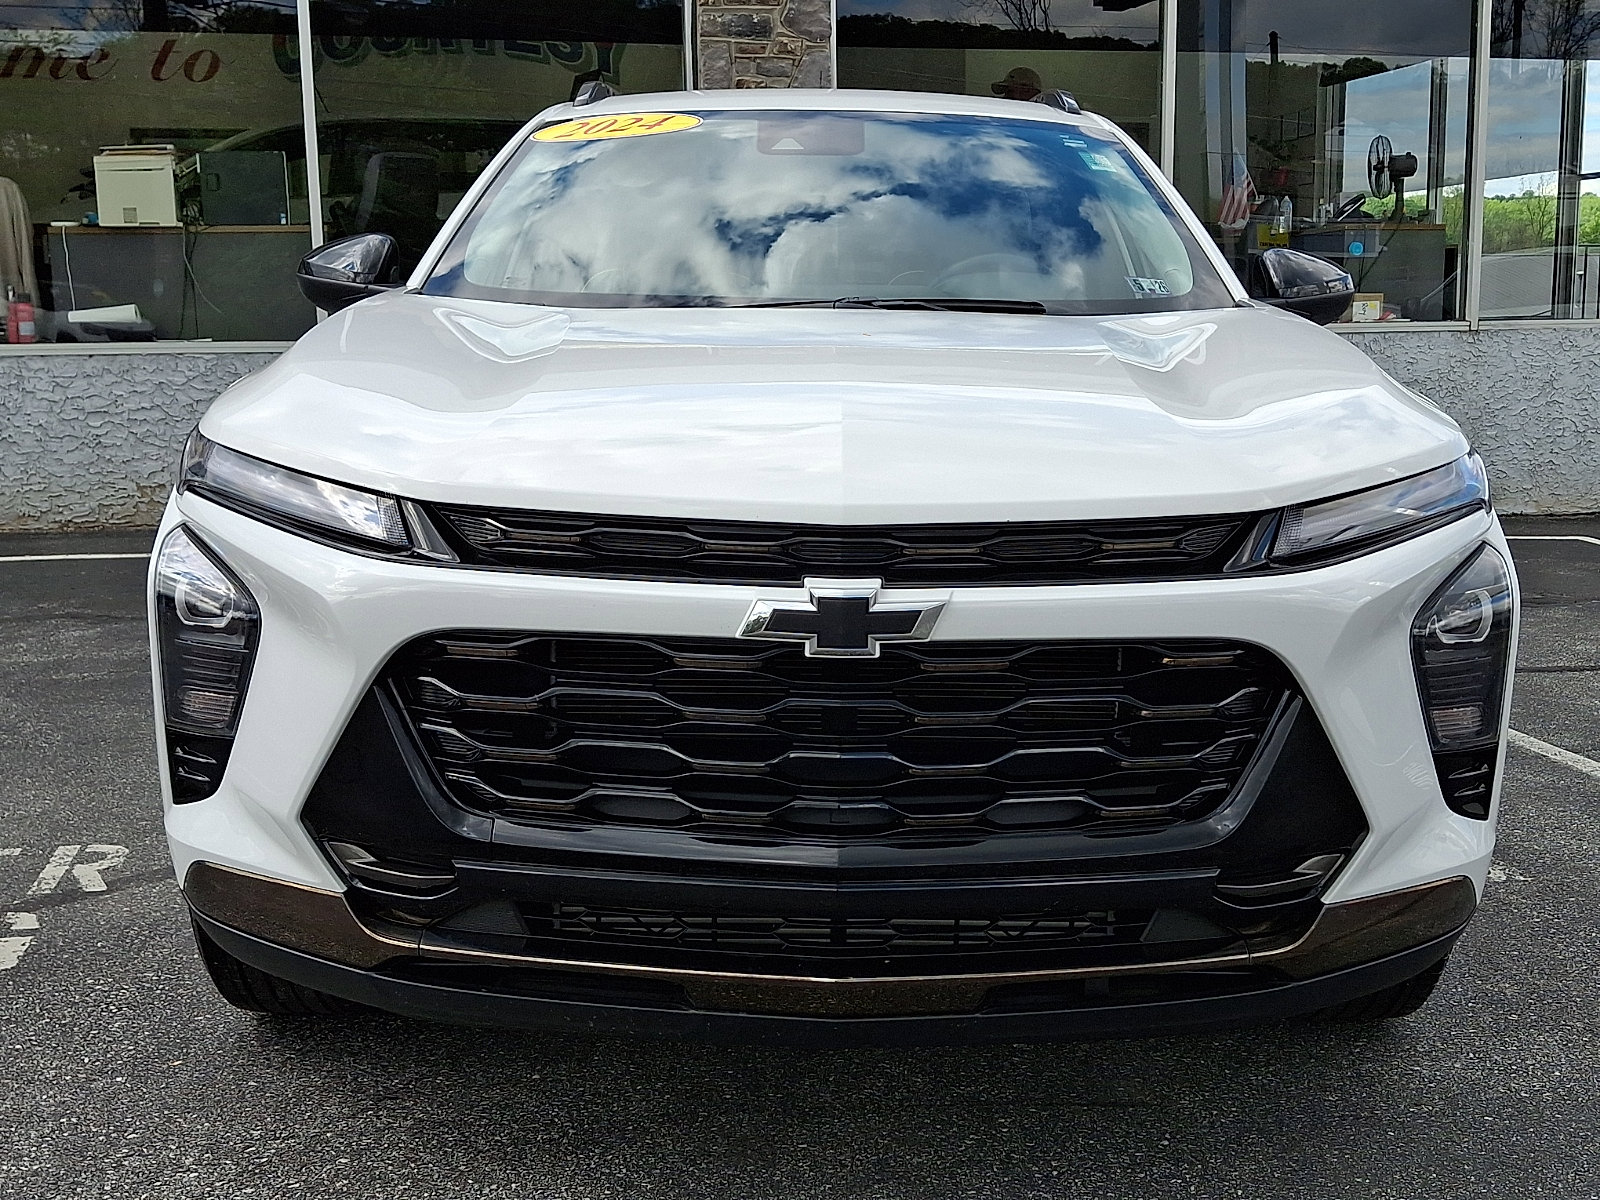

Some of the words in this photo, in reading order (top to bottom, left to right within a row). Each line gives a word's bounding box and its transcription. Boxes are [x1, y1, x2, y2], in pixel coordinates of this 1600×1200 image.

[151, 39, 232, 82] to
[554, 115, 676, 139] 2024
[1132, 279, 1145, 292] 5
[0, 844, 129, 895] R
